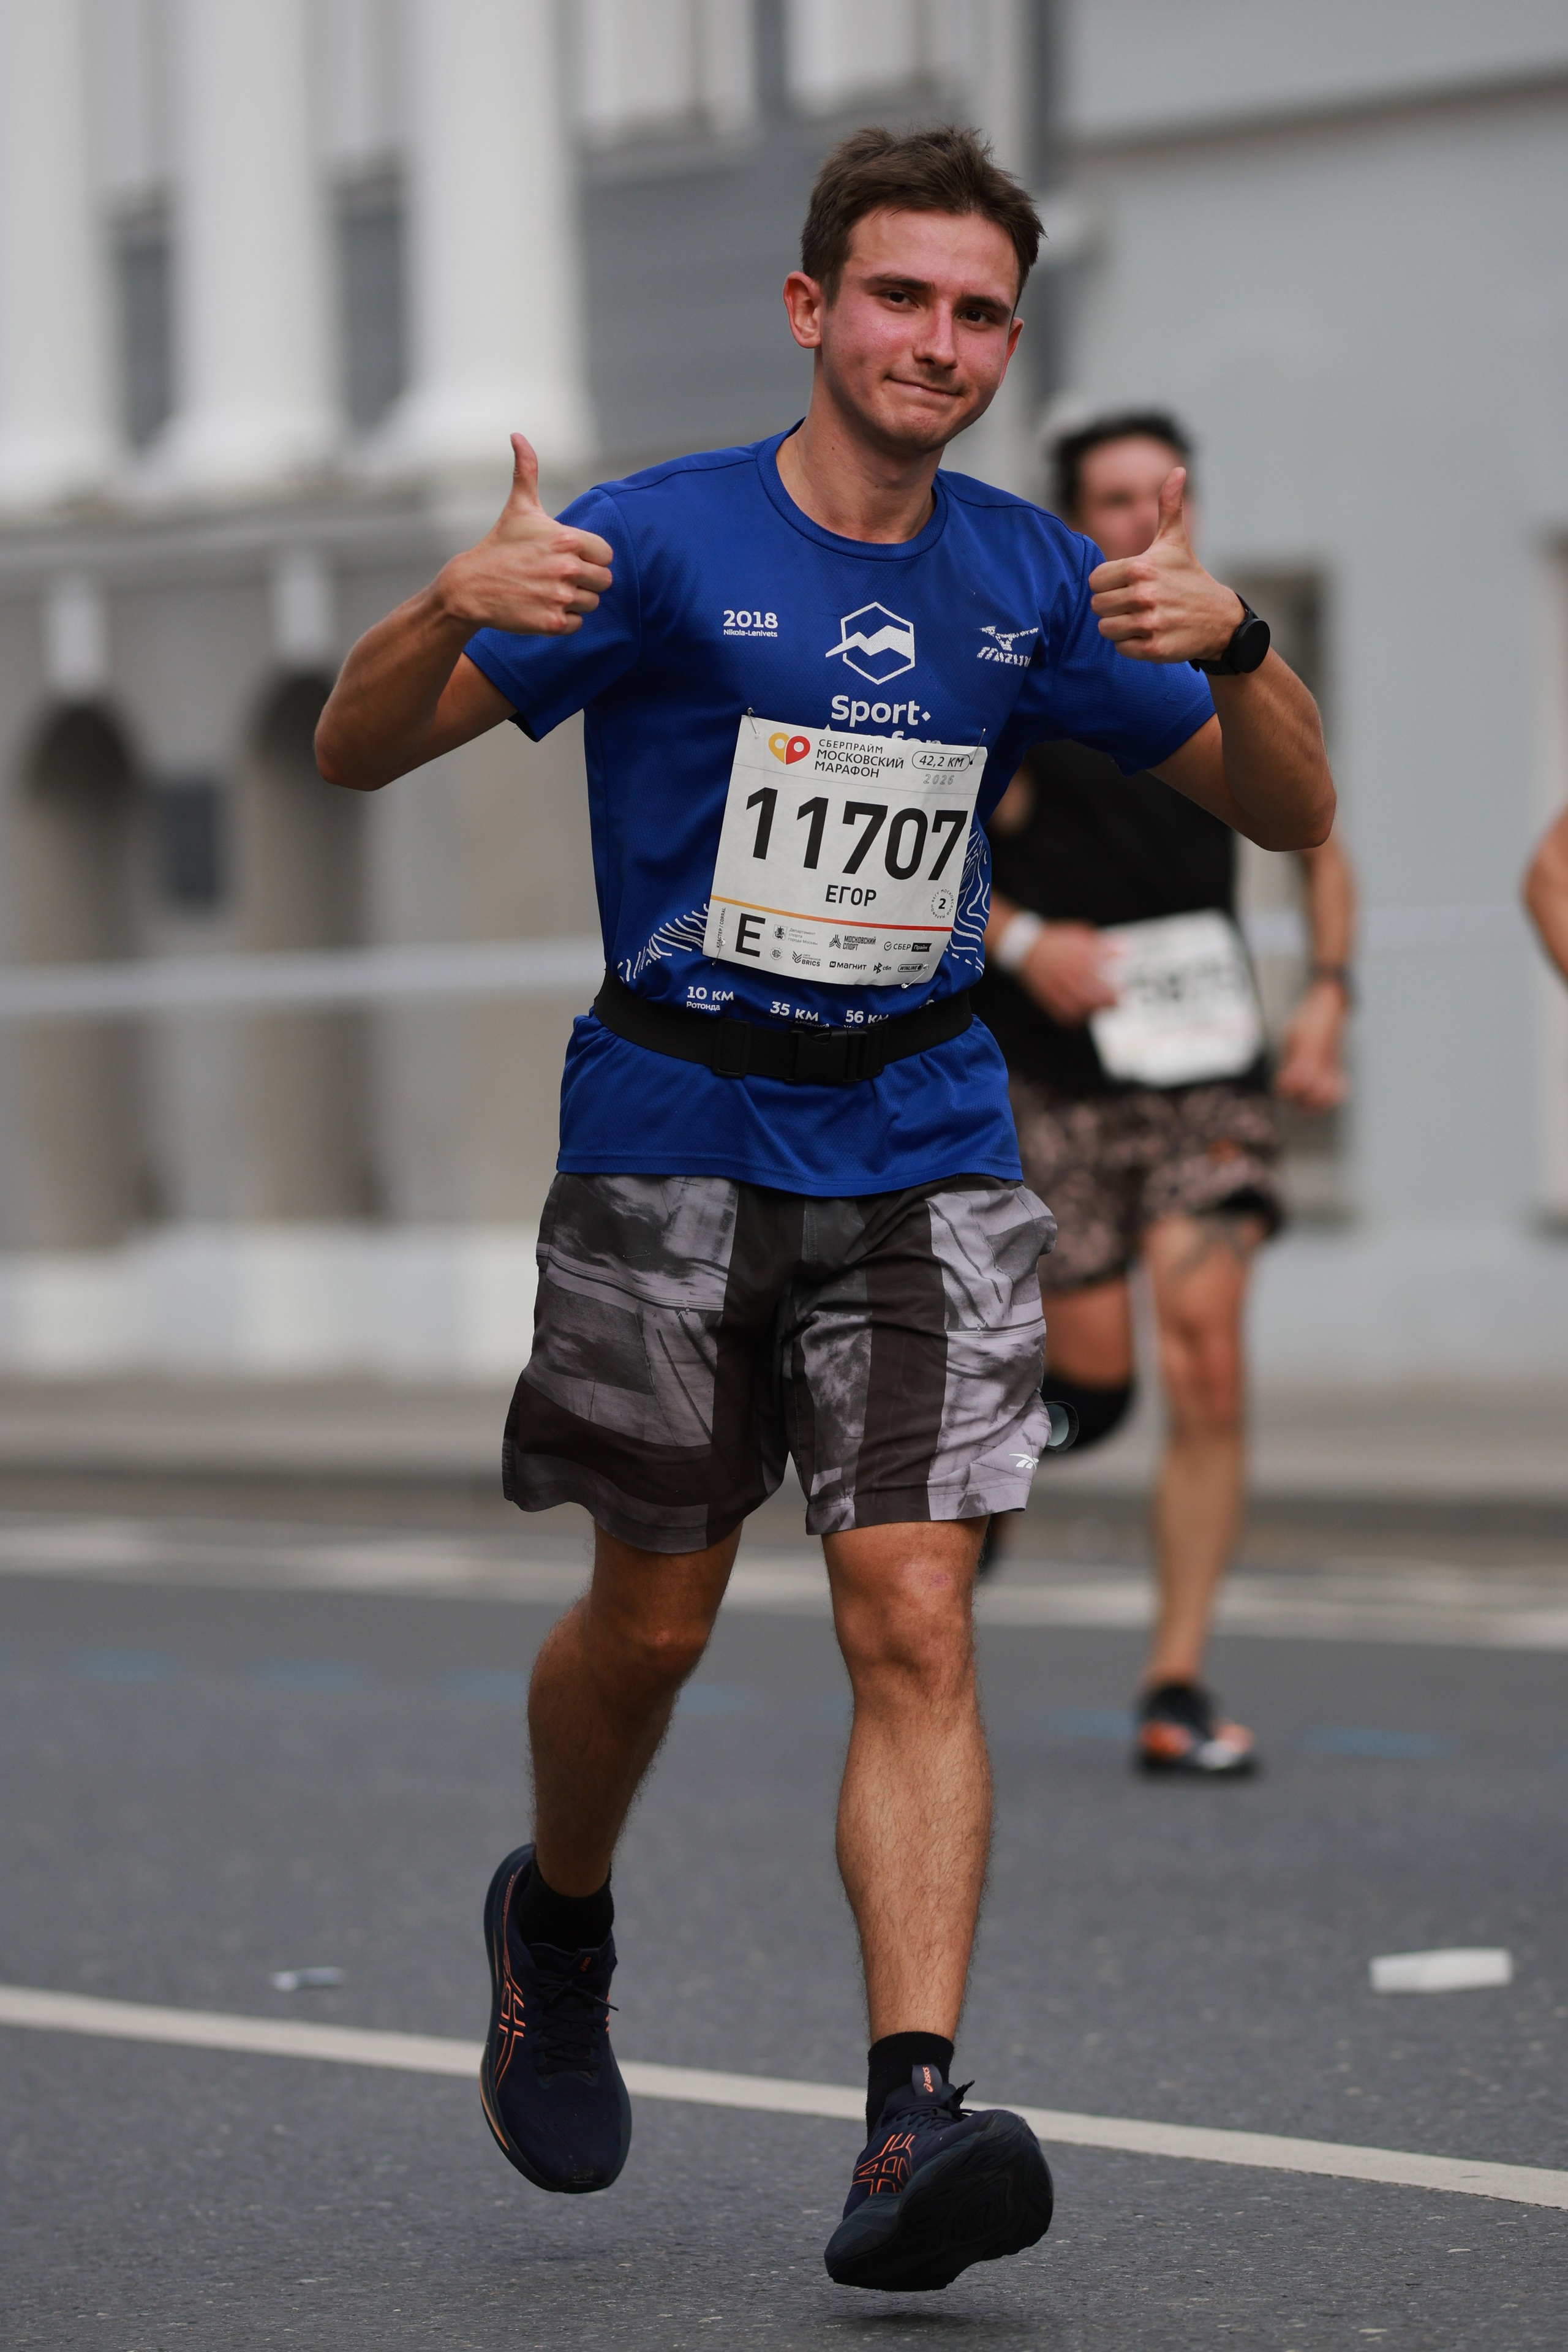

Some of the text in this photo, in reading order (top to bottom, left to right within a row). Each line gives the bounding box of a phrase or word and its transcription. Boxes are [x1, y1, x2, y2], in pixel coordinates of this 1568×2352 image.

[723, 610, 778, 628] 2018
[819, 739, 883, 754] СБЕРПРАЙМ
[816, 749, 904, 769] МОСКОВСКИЙ
[919, 755, 965, 768] 42,2 КМ
[814, 761, 880, 778] МАРАФОН
[923, 774, 955, 785] 2026
[746, 787, 968, 881] 11707
[825, 884, 877, 907] ЕГОР
[938, 898, 946, 909] 2
[844, 935, 876, 945] МОСКОВСКИЙ
[687, 986, 707, 1000] 10
[686, 1001, 721, 1011] Ротонда
[770, 1001, 791, 1016] 35
[845, 1010, 864, 1023] 56
